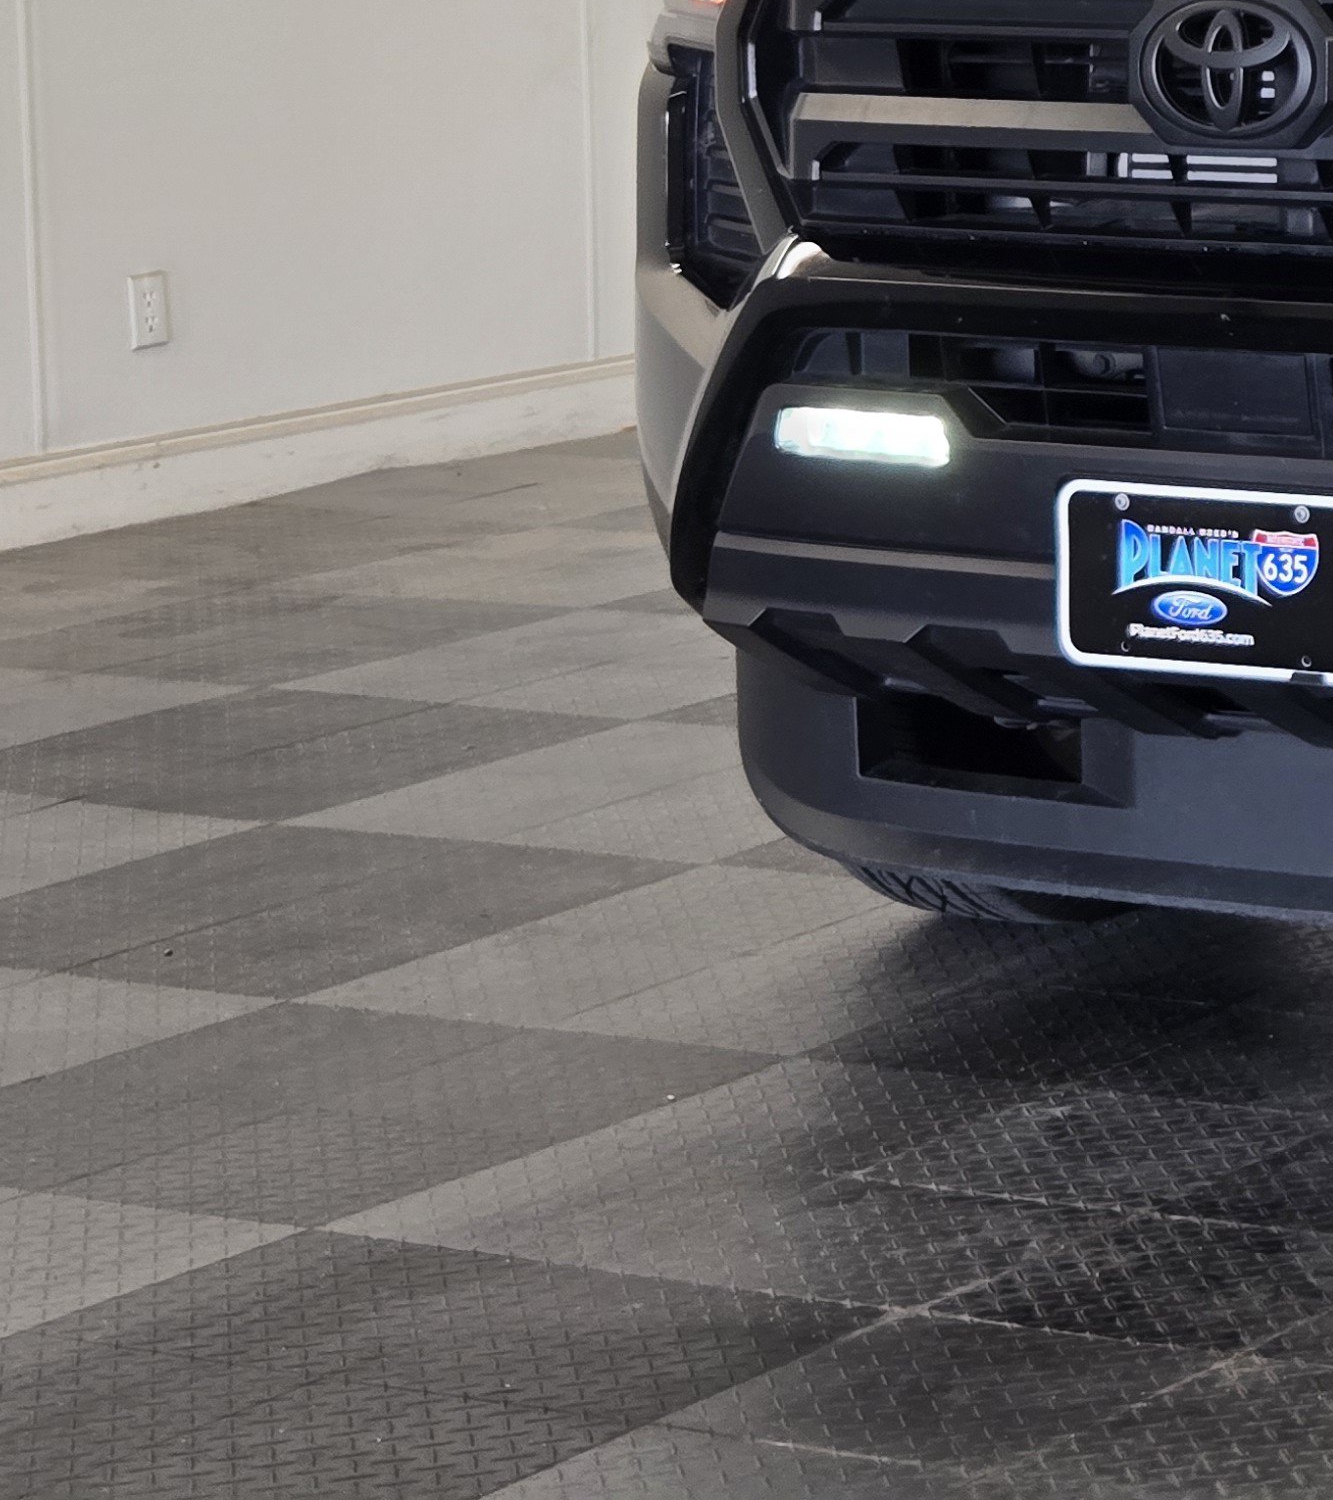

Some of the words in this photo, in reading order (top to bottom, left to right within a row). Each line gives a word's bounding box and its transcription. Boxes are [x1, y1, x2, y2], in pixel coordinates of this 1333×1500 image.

[1120, 518, 1262, 597] PLANET
[1262, 552, 1308, 583] 635
[1168, 598, 1212, 621] Ford
[1128, 622, 1255, 647] PlanetFord635.com
